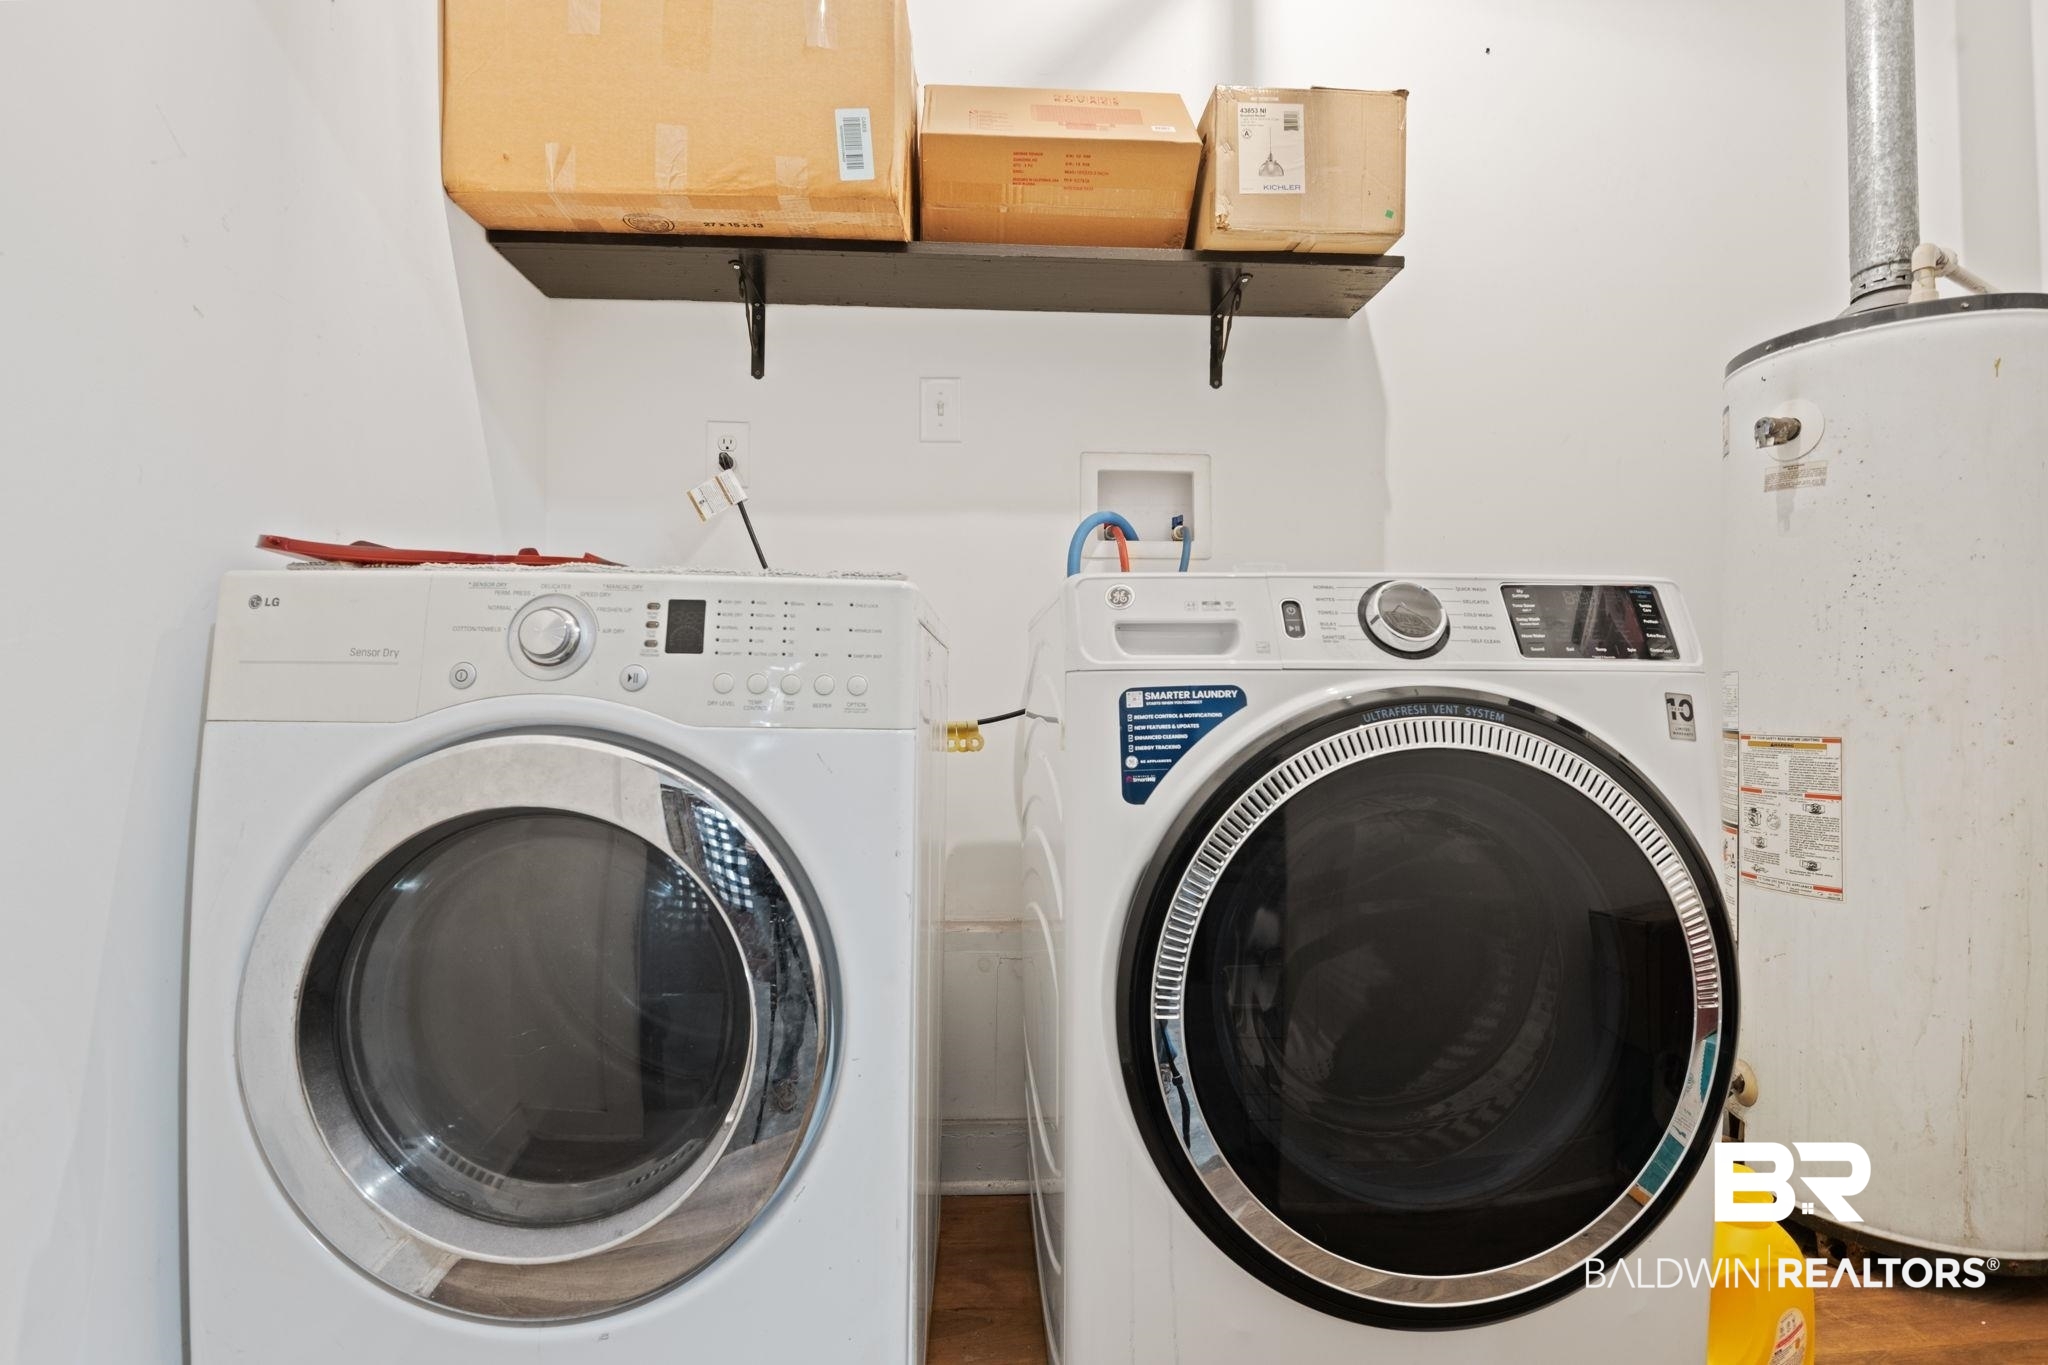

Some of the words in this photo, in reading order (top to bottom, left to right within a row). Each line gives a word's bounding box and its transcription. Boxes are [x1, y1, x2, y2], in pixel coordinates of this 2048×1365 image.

[264, 597, 280, 607] LG
[350, 647, 381, 657] Sensor
[382, 647, 400, 659] Dry
[1144, 690, 1191, 700] SMARTER
[1192, 689, 1238, 699] LAUNDRY
[1363, 705, 1427, 722] ULTRAFRESH
[1432, 704, 1459, 715] VENT
[1465, 706, 1505, 722] SYSTEM
[1666, 698, 1694, 722] 10
